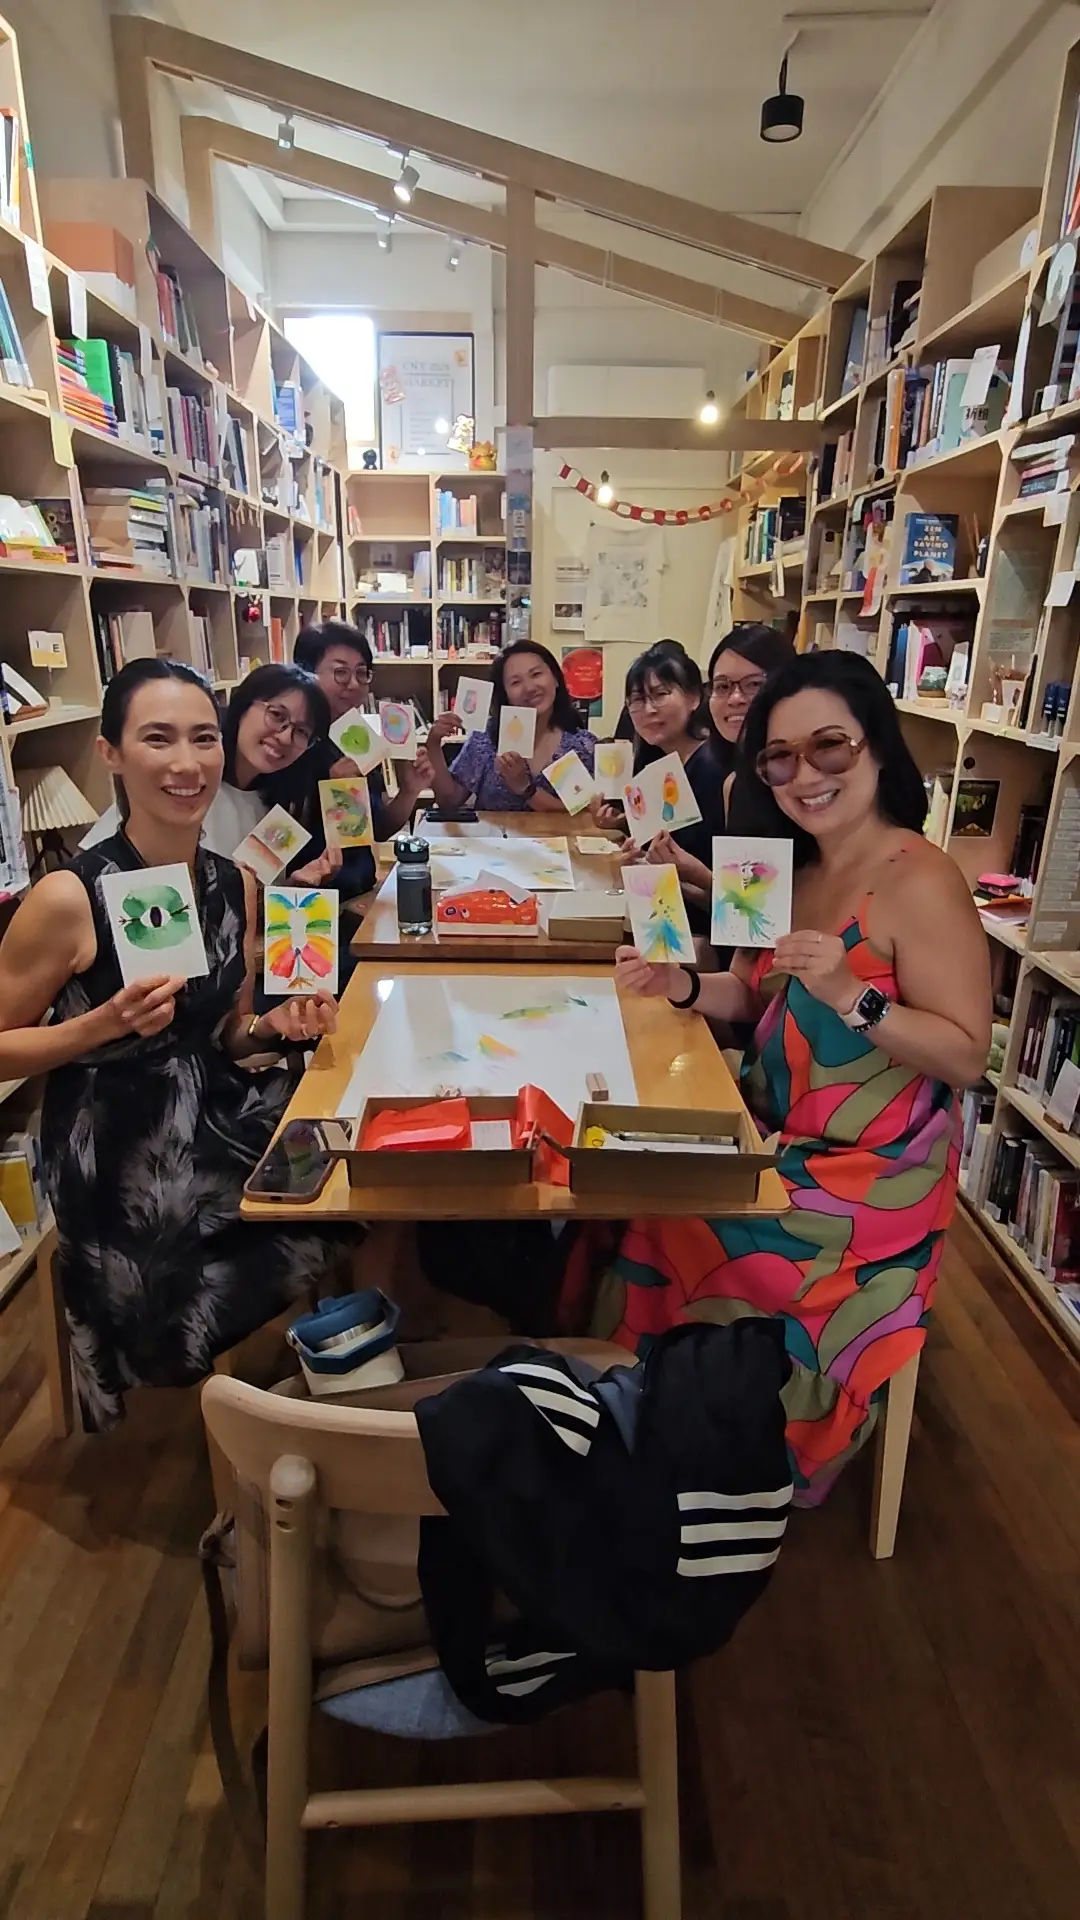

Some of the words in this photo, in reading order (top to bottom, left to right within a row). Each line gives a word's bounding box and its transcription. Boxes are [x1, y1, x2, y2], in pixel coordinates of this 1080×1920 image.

[923, 525, 943, 533] ZEN
[913, 540, 949, 549] SAVING
[913, 550, 947, 558] PLANET
